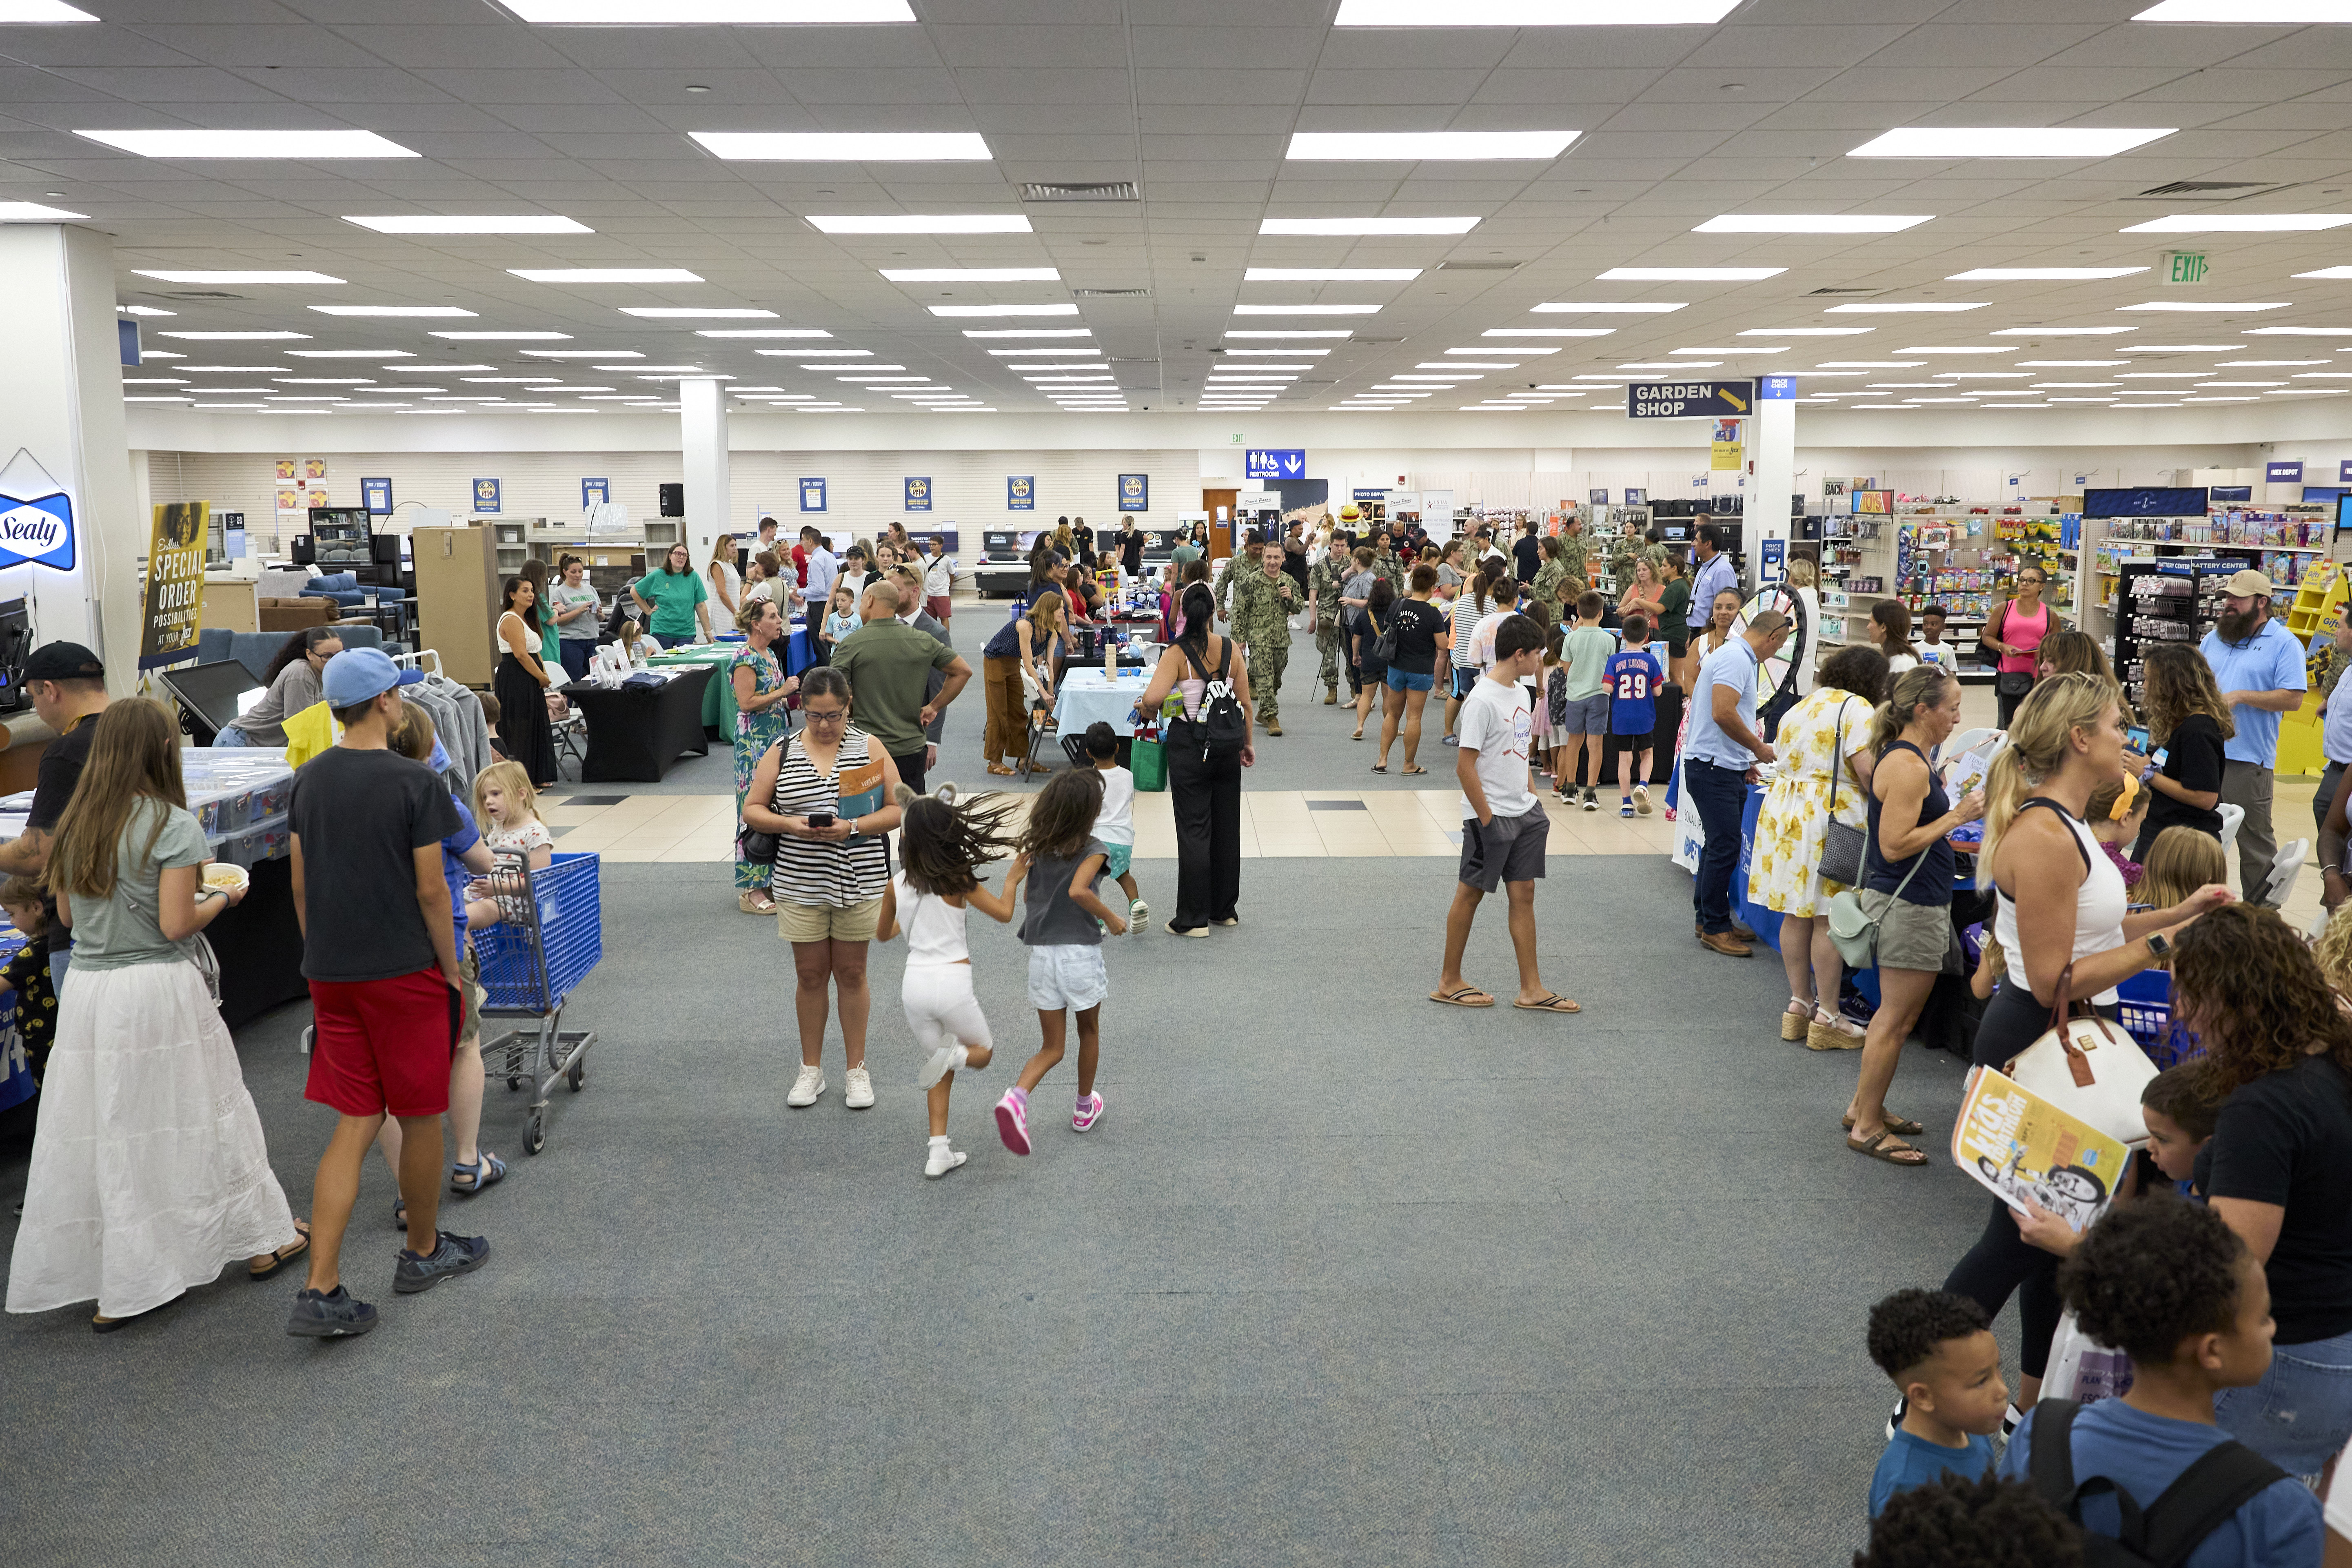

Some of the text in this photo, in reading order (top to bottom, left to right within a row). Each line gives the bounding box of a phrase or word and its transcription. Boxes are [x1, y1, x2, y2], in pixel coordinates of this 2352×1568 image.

[2172, 256, 2205, 282] EXIT
[1636, 385, 1712, 400] GARDEN
[1636, 402, 1685, 416] SHOP
[1232, 434, 1243, 442] EXIT
[1825, 484, 1843, 495] BACK
[1862, 493, 1881, 511] TOYS
[0, 517, 57, 547] Sealy
[154, 549, 203, 581] SPECIAL
[159, 579, 196, 610] ORDER
[153, 608, 197, 628] POSSIBILITIES
[2323, 618, 2339, 628] Gift
[158, 625, 192, 646] AT YOUR NEX
[1628, 659, 1649, 672] LUMBER
[1619, 674, 1646, 699] 29
[1972, 756, 1983, 766] Love
[1684, 809, 1697, 827] EQUAL
[1743, 833, 1751, 852] The
[1742, 857, 1751, 875] Cen
[1988, 1093, 2028, 1163] TRIATHLON
[2082, 1375, 2101, 1384] PLAN
